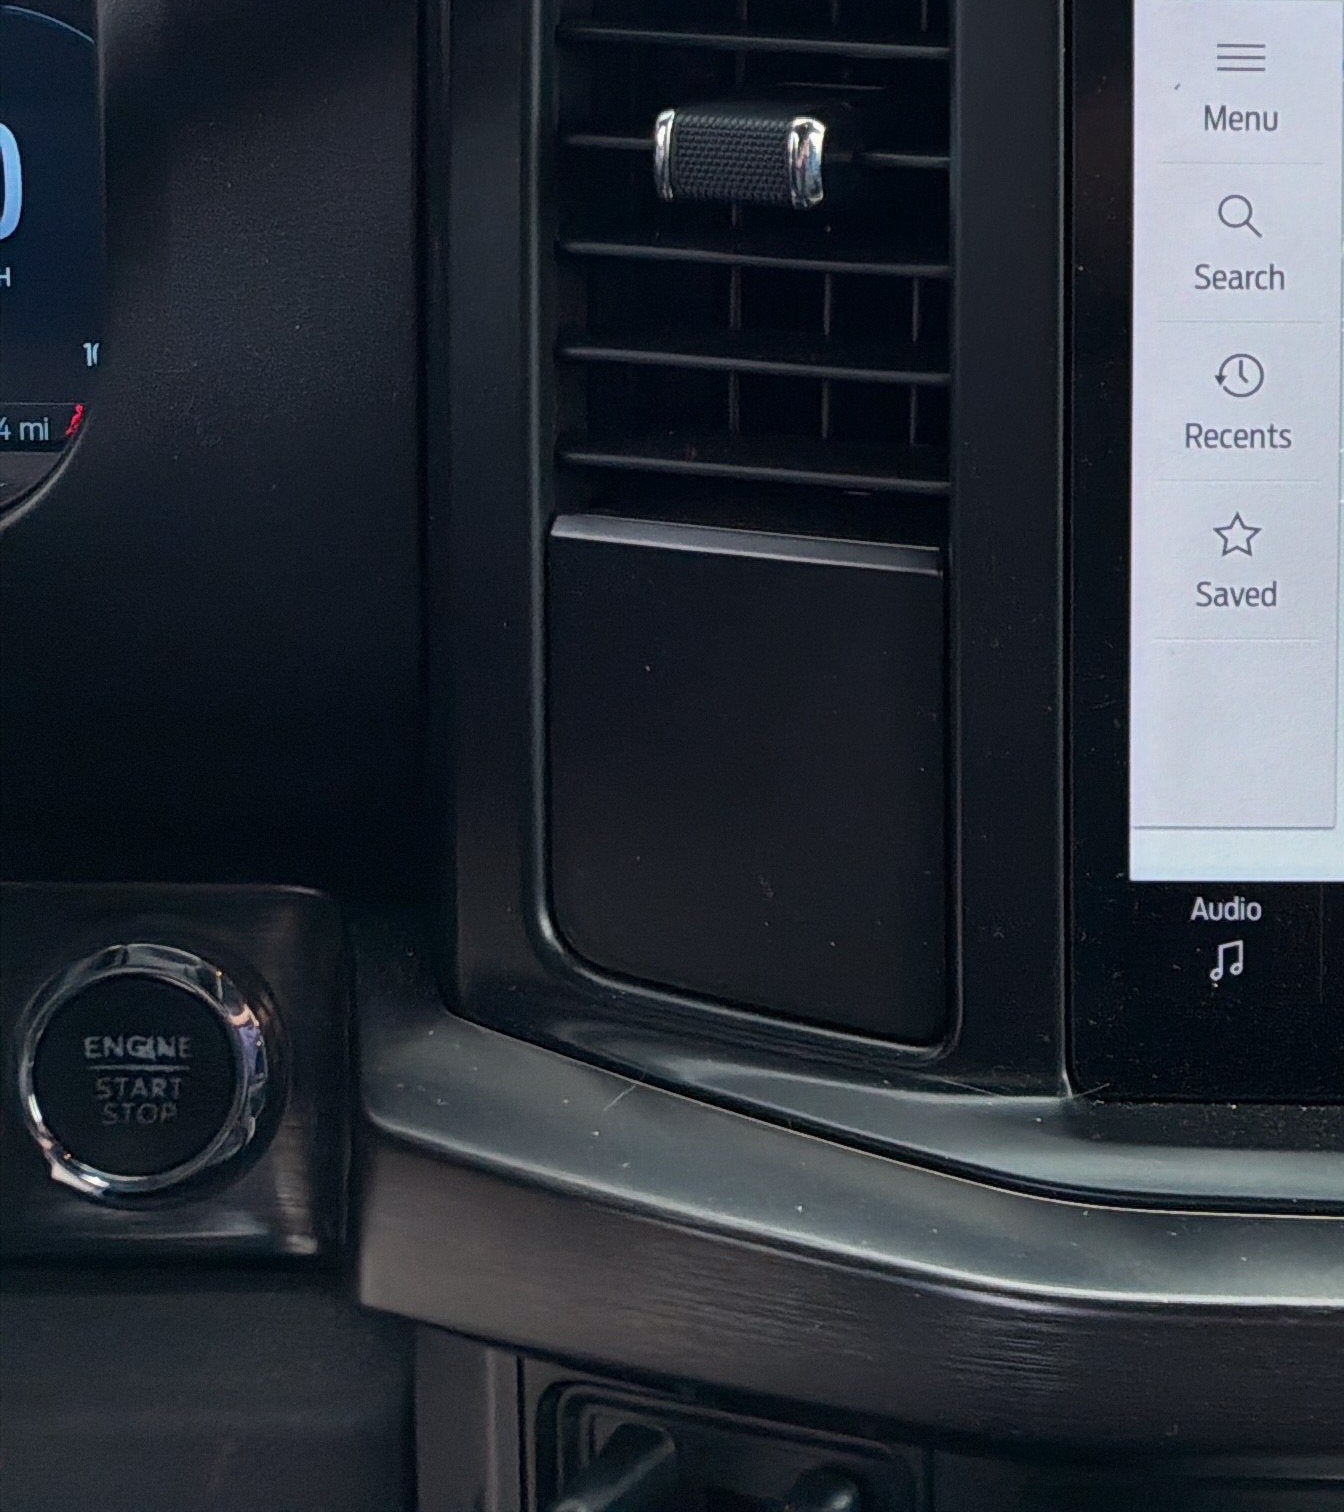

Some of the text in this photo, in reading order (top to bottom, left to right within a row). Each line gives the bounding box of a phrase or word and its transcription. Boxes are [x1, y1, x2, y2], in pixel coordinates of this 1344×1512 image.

[1204, 104, 1278, 132] Menu
[1194, 263, 1285, 290] Search
[19, 416, 49, 441] mi
[1185, 422, 1292, 449] Recents
[1196, 580, 1277, 608] Saved
[1190, 895, 1262, 922] Audio
[84, 1035, 192, 1061] ENGINE
[96, 1077, 183, 1100] START
[102, 1102, 178, 1125] STOP
